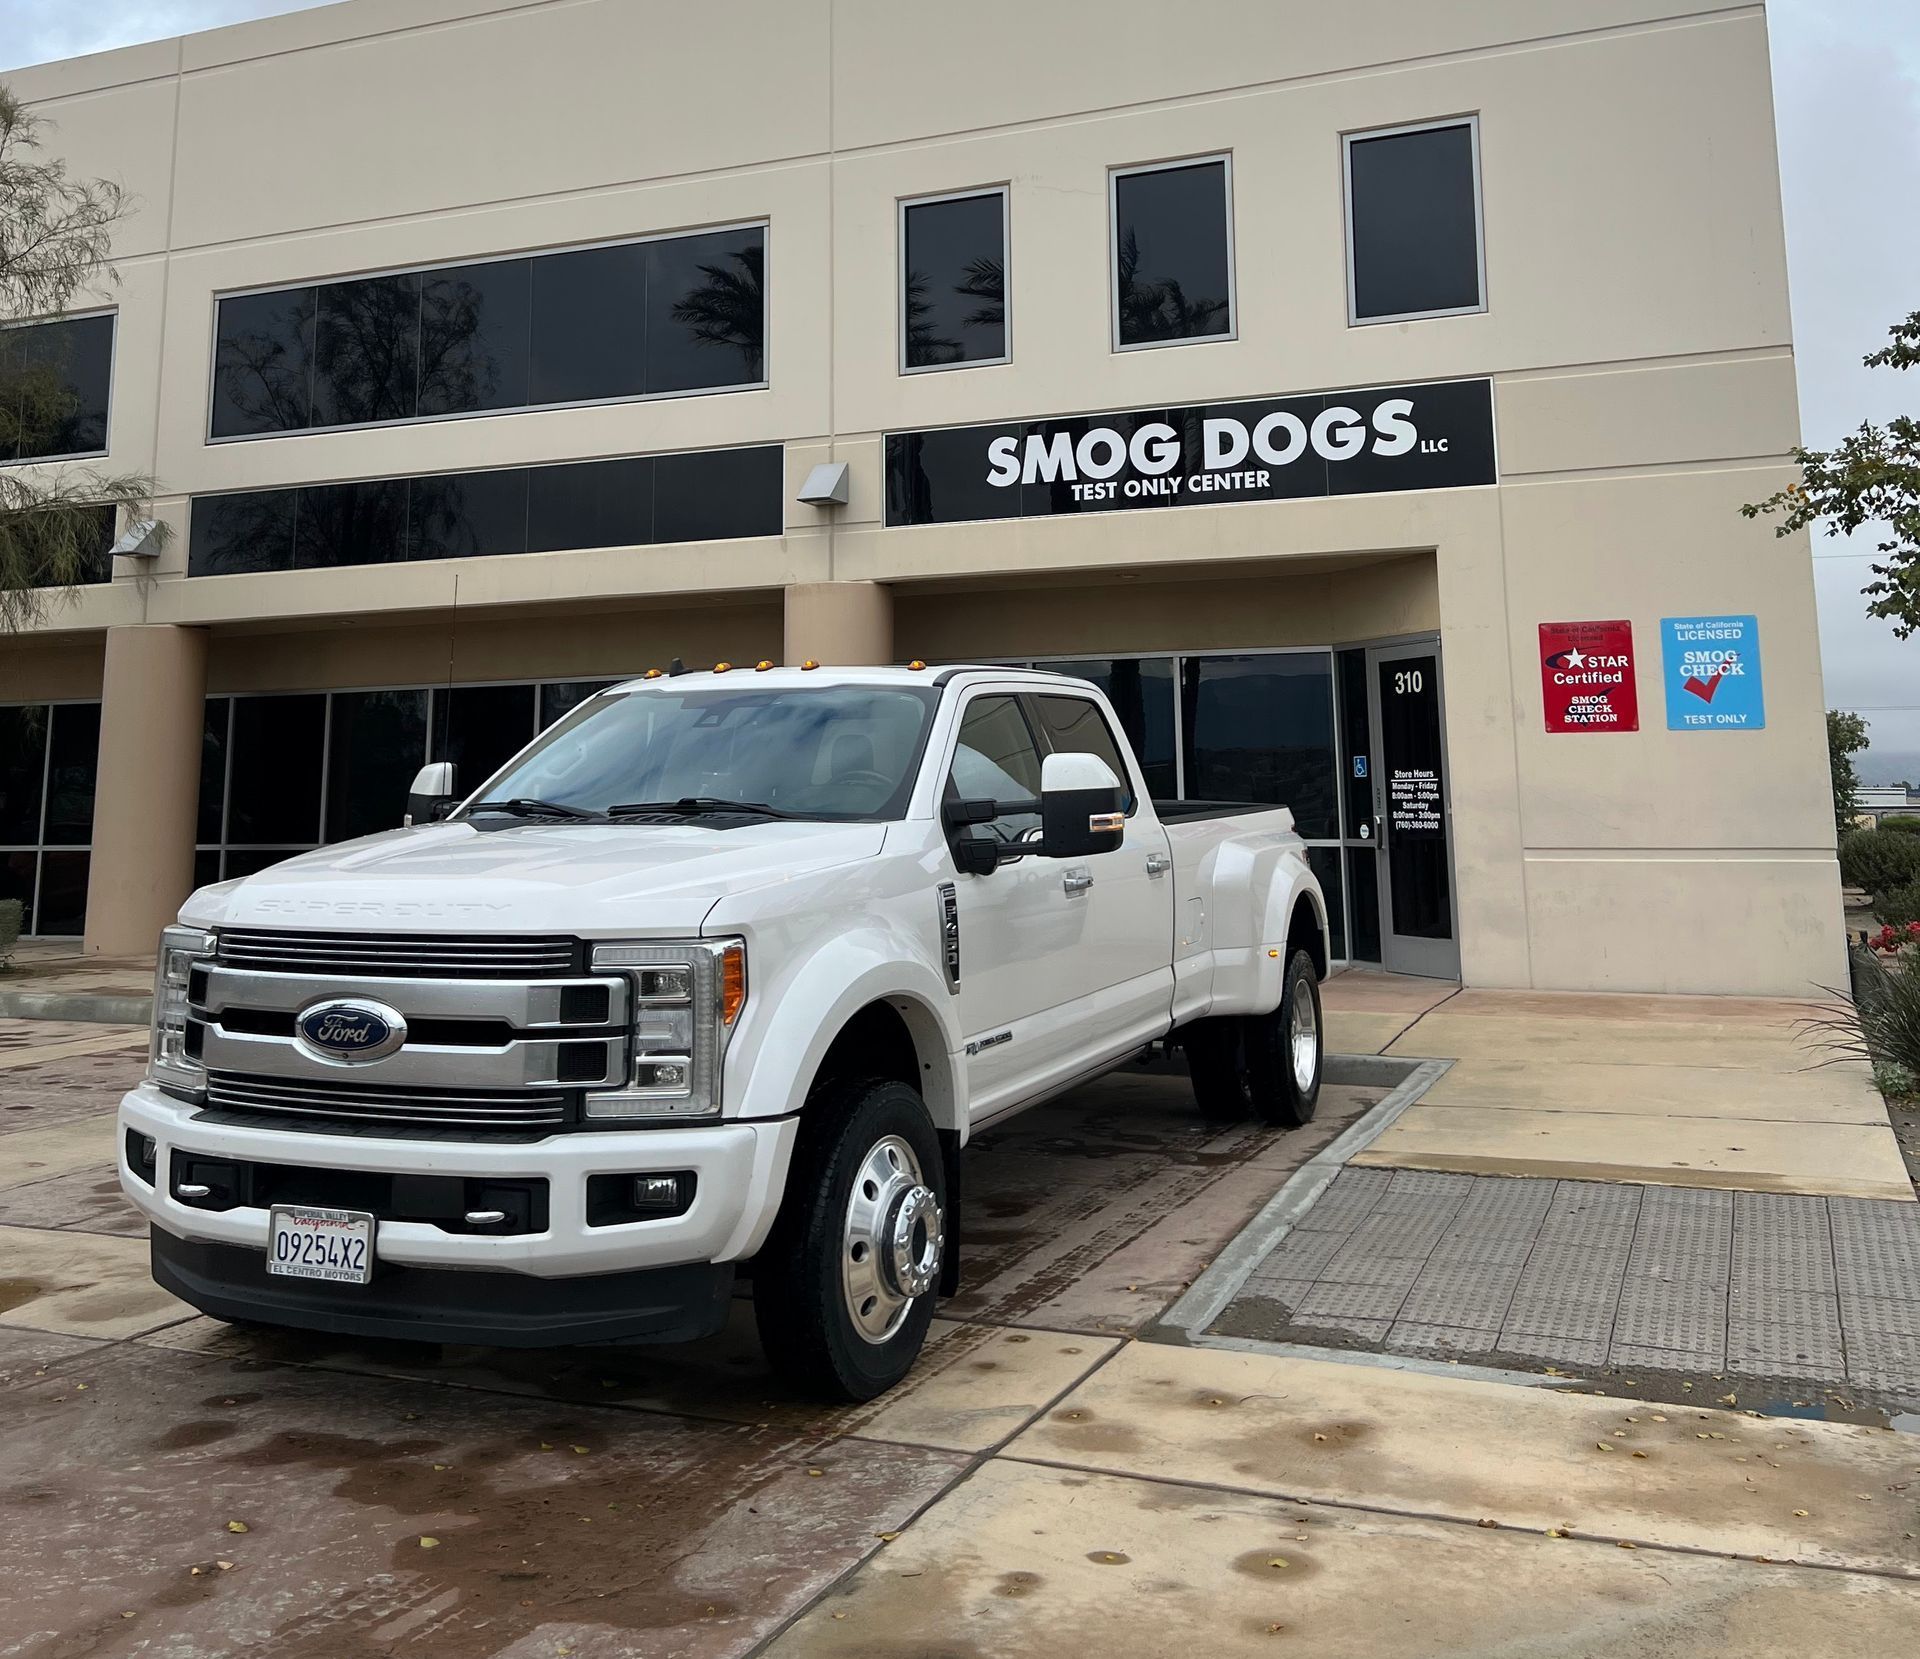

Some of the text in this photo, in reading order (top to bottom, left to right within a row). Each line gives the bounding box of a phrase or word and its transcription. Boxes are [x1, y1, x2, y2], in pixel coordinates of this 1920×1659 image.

[986, 398, 1449, 487] SMOG DOGS LLC
[1071, 470, 1271, 501] TEST ONLY CENTER
[1673, 620, 1744, 630] State of California
[1677, 629, 1742, 641] LICENSED
[1588, 655, 1629, 668] STAR
[1684, 650, 1738, 663] SMOG
[1679, 663, 1745, 677] CHECK
[1395, 671, 1423, 694] 310
[1553, 671, 1623, 685] Certified
[1571, 695, 1608, 704] SMOG
[1568, 704, 1613, 714] CHECK
[1564, 713, 1618, 723] STATION
[1684, 714, 1747, 724] TEST ONLY
[1394, 769, 1434, 778] Store Hours
[1392, 782, 1414, 791] Monday
[1418, 781, 1437, 791] Friday
[1402, 801, 1429, 811] Saturday
[254, 898, 512, 919] SUPER DUTY
[317, 1013, 370, 1045] Ford
[277, 1230, 366, 1270] 09254X2
[273, 1265, 362, 1282] EL CENTRO MOTORS
